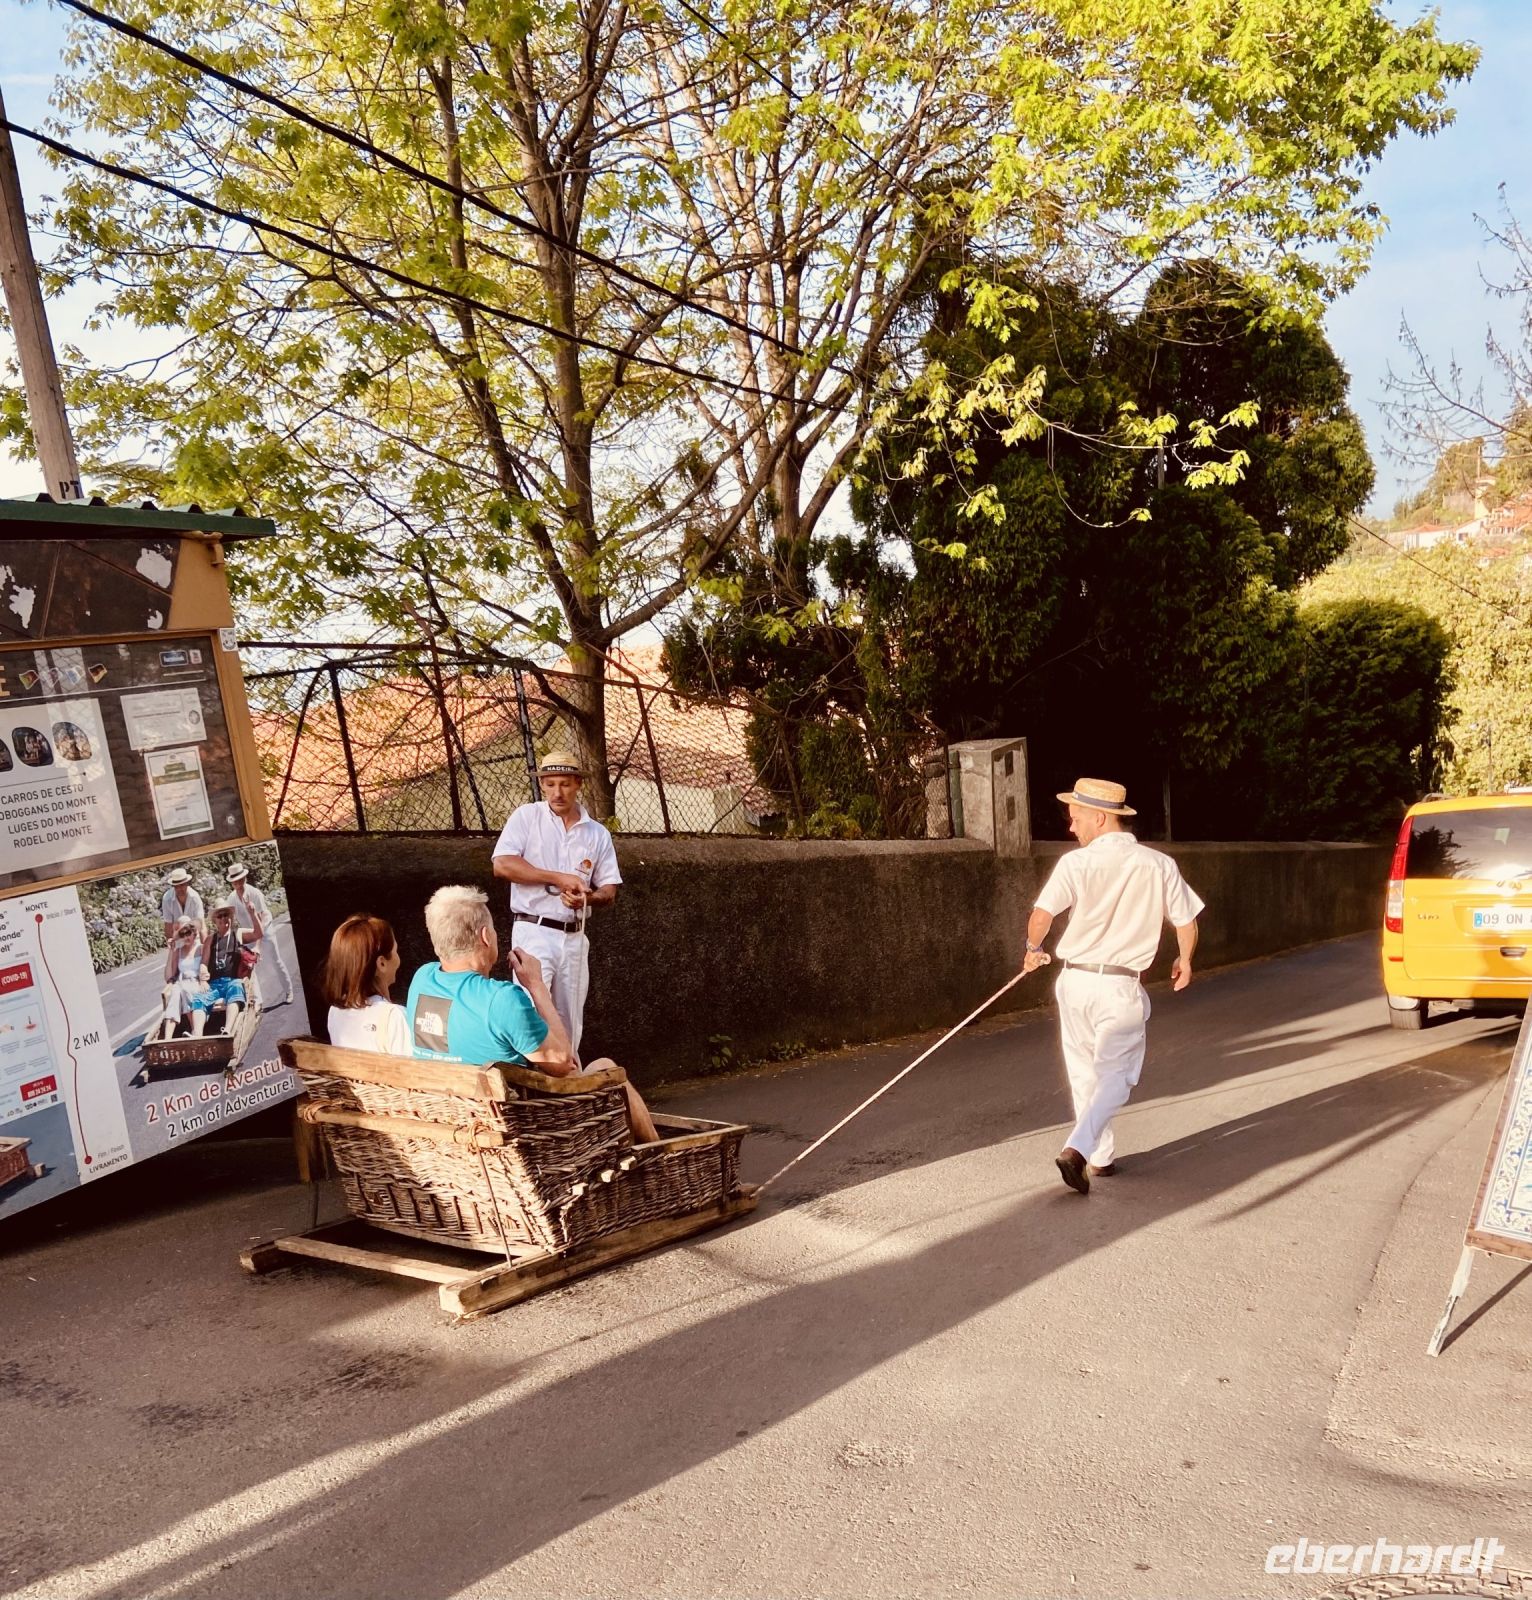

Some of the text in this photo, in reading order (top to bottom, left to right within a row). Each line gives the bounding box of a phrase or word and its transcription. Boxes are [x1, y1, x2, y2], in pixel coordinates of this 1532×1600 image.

[1, 784, 84, 805] CARROS DE CESTO
[52, 801, 64, 812] DO
[66, 795, 98, 809] MONTE
[8, 811, 87, 835] LUGES DO MONTE
[13, 825, 93, 848] RODEL DO MONTE
[25, 901, 48, 912] MONTE
[1483, 913, 1499, 924] 09
[1506, 913, 1523, 924] ON
[73, 1031, 100, 1049] 2 KM
[146, 1104, 158, 1123] 2
[164, 1094, 192, 1116] Km
[199, 1082, 220, 1102] de
[168, 1077, 295, 1137] 2 km of Adventure!
[89, 1153, 128, 1174] LIVRAMENTO
